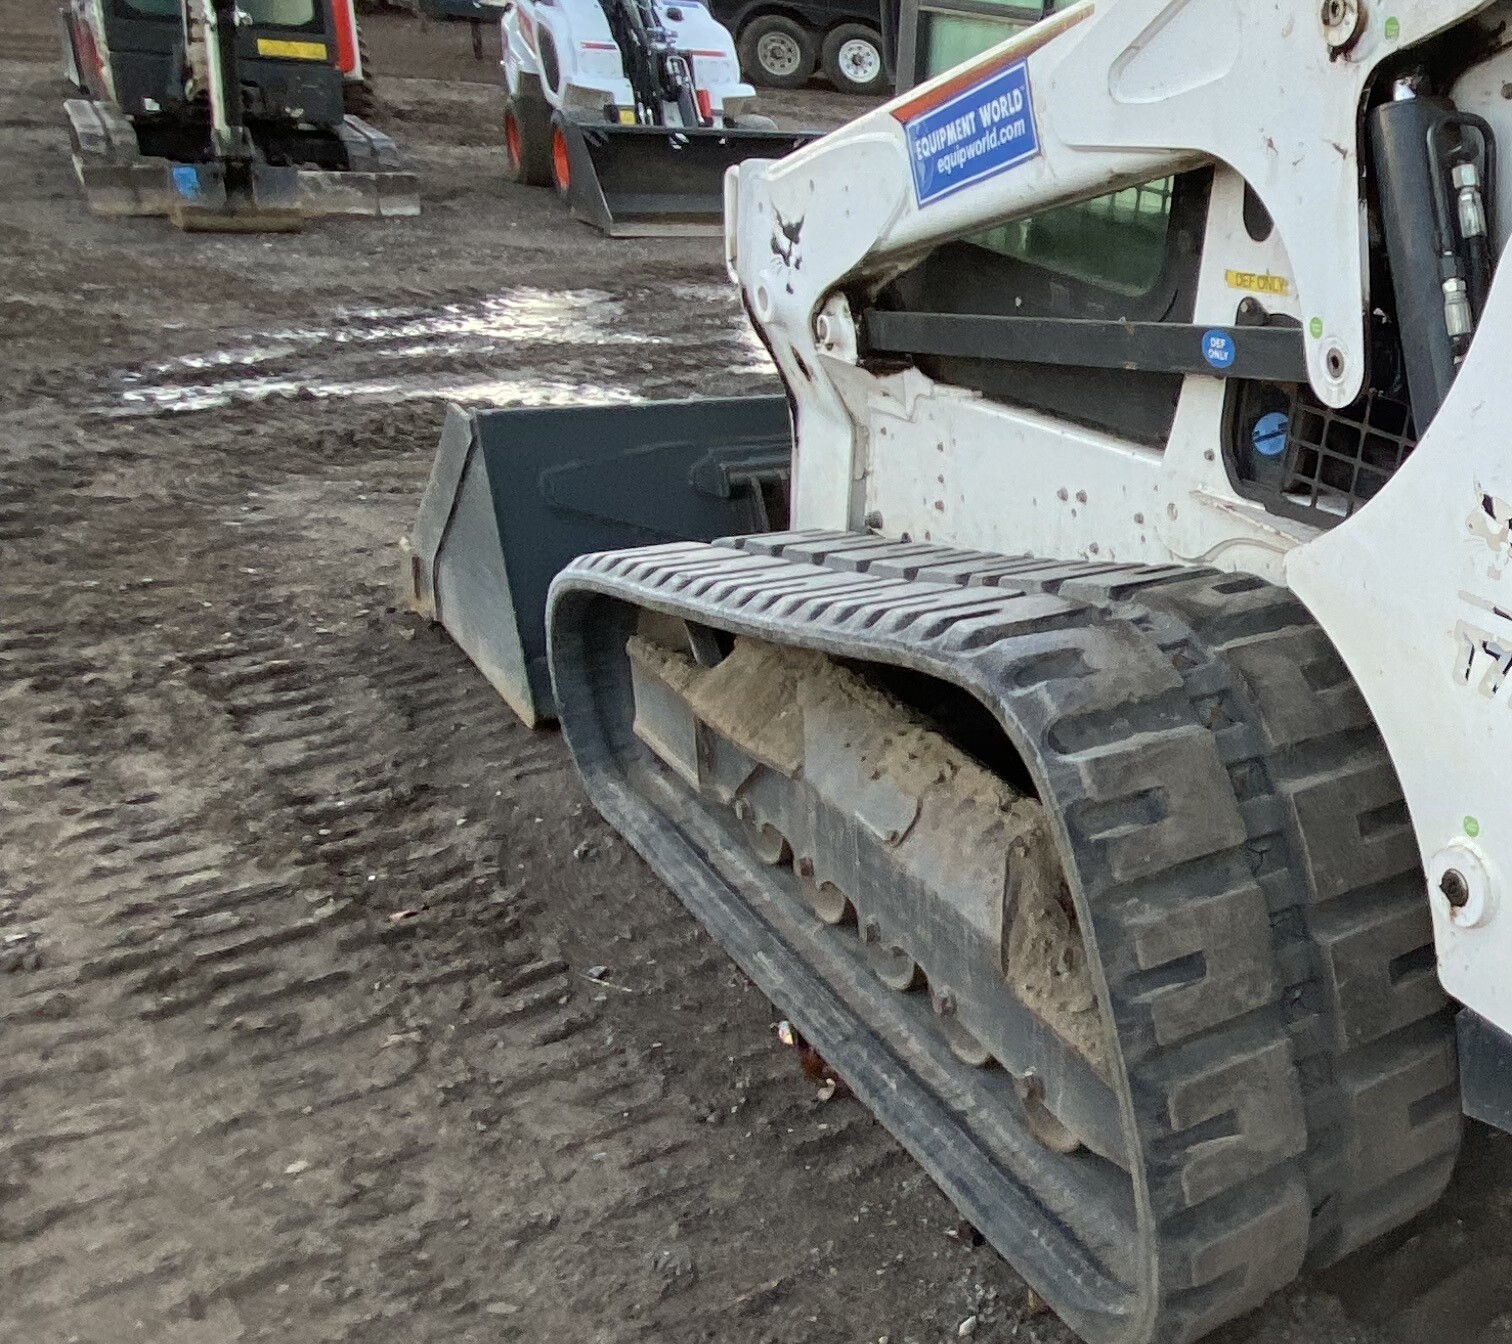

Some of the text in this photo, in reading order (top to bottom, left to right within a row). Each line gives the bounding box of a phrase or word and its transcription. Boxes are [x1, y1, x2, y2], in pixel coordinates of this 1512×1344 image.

[916, 88, 1023, 160] EQUIPMENT WORLD
[937, 119, 1026, 174] equipworld.com
[1235, 272, 1285, 293] DEF ONLY
[1210, 337, 1226, 348] DEF
[1208, 348, 1229, 361] ONLY
